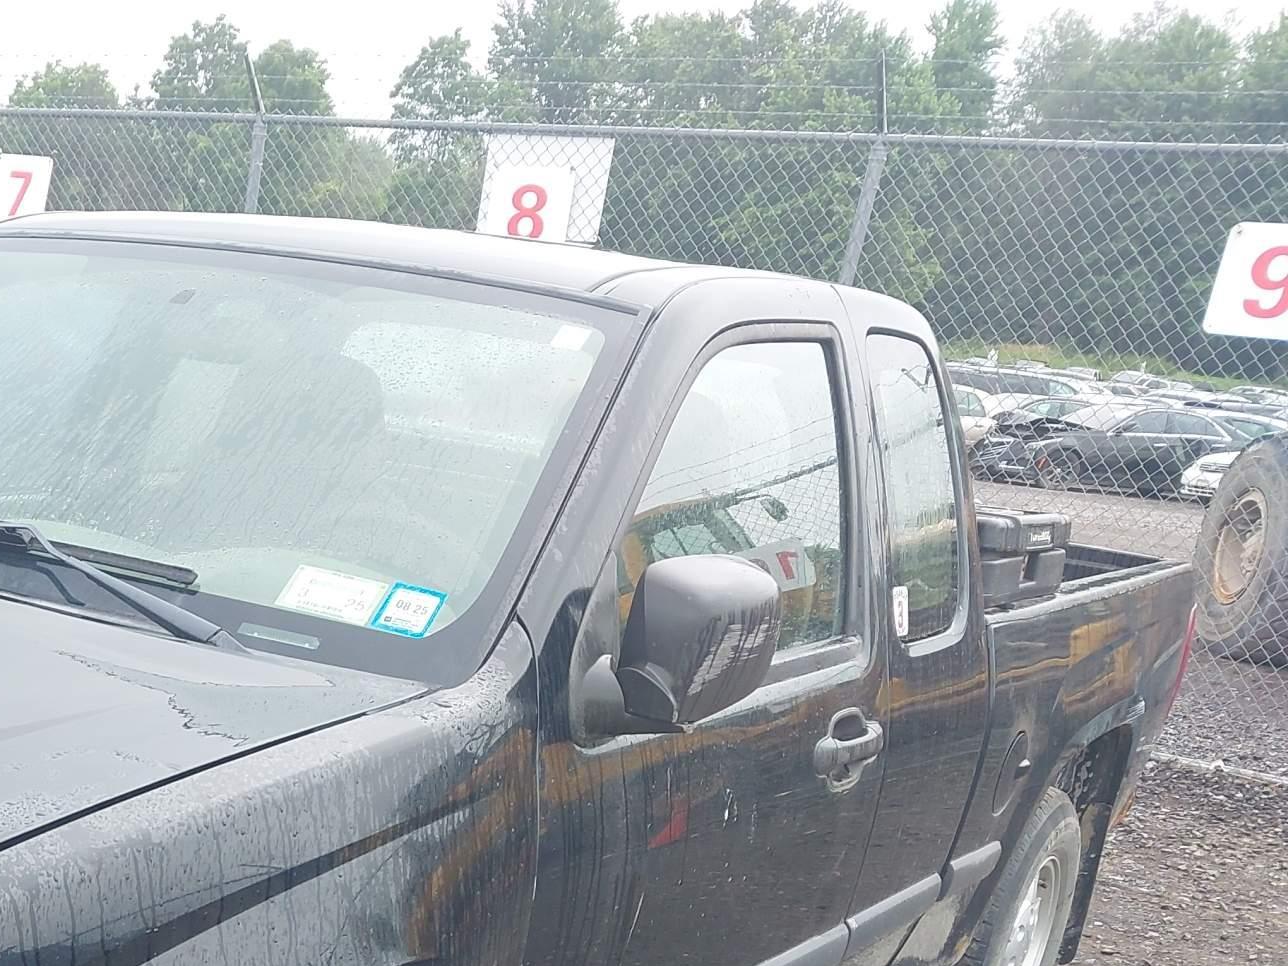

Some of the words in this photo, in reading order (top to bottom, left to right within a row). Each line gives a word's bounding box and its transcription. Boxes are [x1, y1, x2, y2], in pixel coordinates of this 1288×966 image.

[8, 170, 33, 217] 7
[506, 183, 548, 239] 8
[1243, 245, 1288, 319] 9
[395, 599, 411, 611] 08
[413, 603, 428, 616] 25
